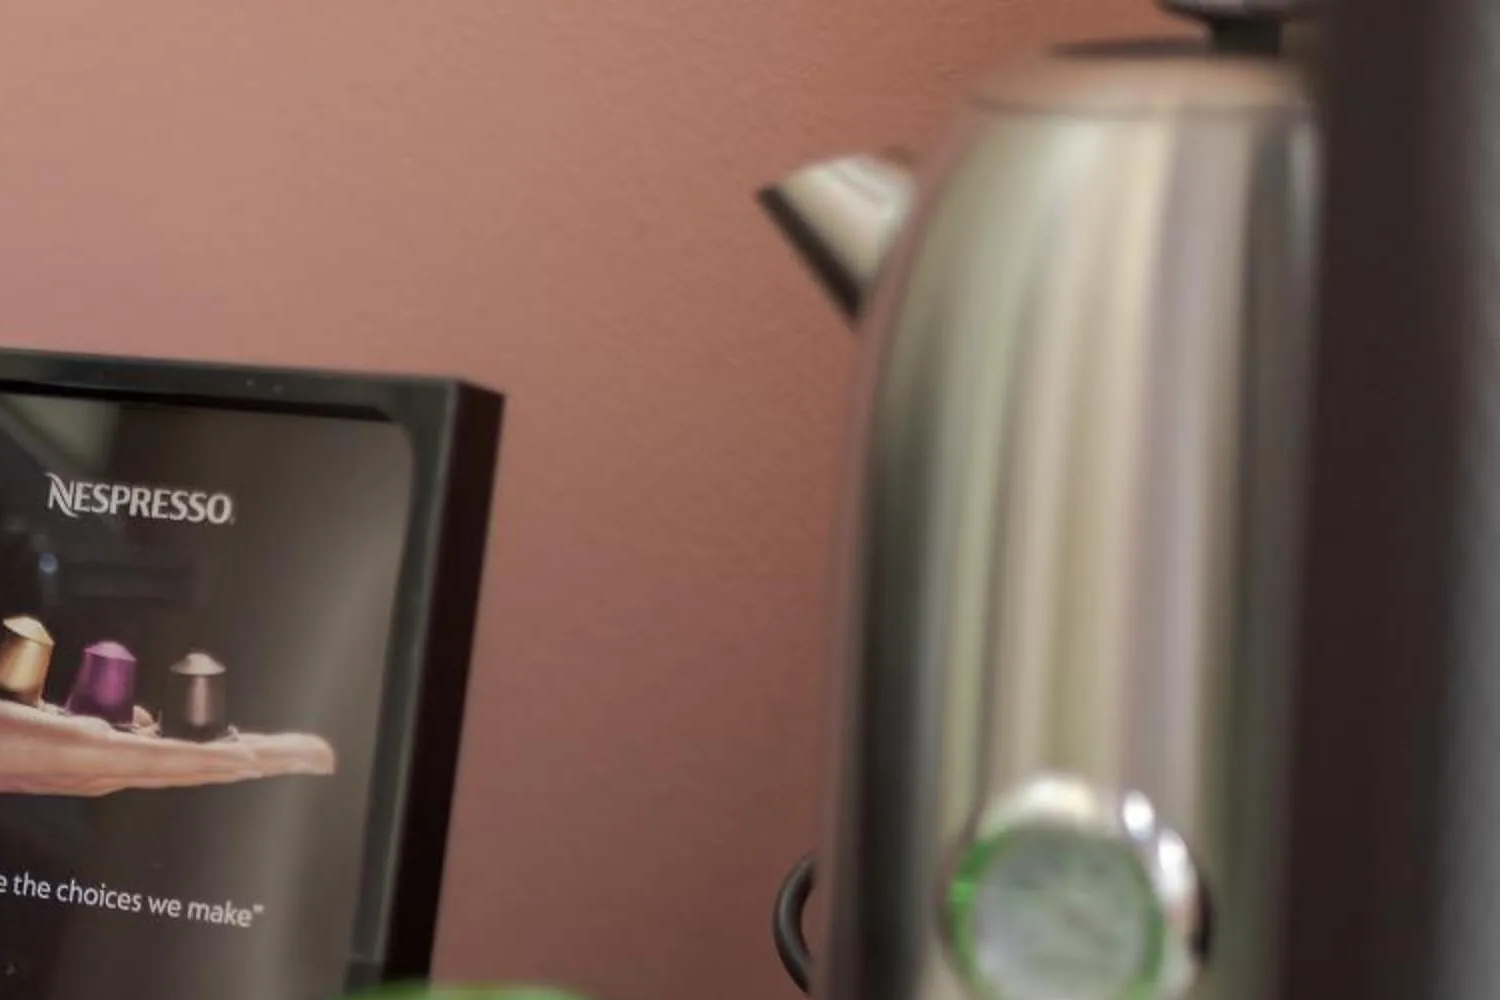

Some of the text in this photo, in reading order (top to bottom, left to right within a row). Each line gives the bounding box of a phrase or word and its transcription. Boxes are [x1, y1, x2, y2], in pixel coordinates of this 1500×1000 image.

[45, 472, 233, 524] NESPRESSO
[12, 872, 51, 899] the
[56, 879, 142, 912] choices
[147, 894, 182, 917] we
